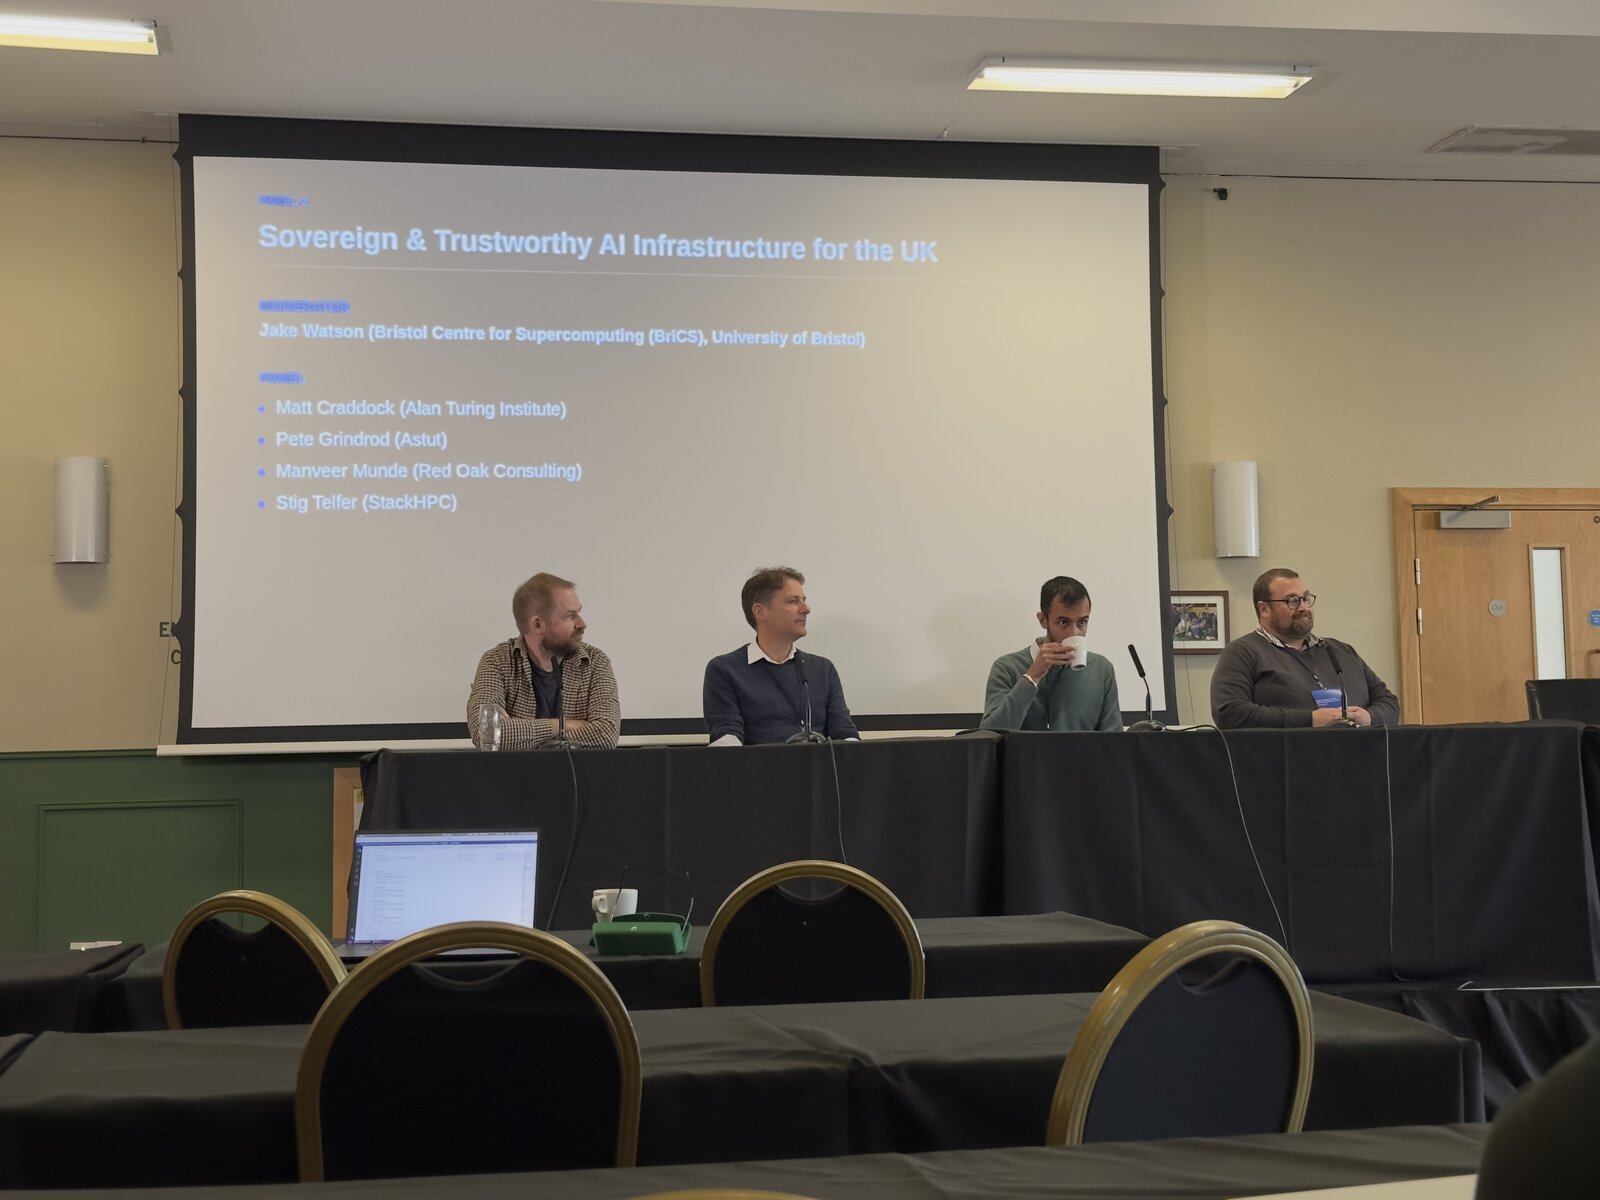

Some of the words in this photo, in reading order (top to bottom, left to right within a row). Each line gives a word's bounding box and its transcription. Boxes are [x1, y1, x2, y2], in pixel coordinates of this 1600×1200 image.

[300, 196, 310, 207] 2
[258, 224, 399, 256] Sovereign
[405, 228, 427, 252] &
[433, 229, 593, 261] Trustworthy
[600, 233, 626, 256] AI
[633, 234, 807, 261] Infrastructure
[812, 237, 849, 261] for
[854, 239, 894, 263] the
[900, 240, 938, 264] UK
[258, 323, 298, 339] Jake
[302, 324, 364, 340] Watson
[368, 323, 428, 342] (Bristol
[431, 326, 486, 341] Centre
[488, 326, 512, 342] for
[515, 327, 645, 347] Supercomputing
[648, 329, 708, 348] (BriCS),
[712, 330, 788, 349] University
[792, 331, 809, 346] of
[811, 332, 867, 350] Bristol)
[276, 400, 312, 416] Matt
[317, 400, 395, 416] Craddock
[399, 400, 442, 419] (Alan
[446, 401, 496, 420] Turing
[499, 401, 567, 420] Institute)
[276, 431, 314, 447] Pete
[318, 431, 390, 448] Grindrod
[394, 431, 448, 450] (Astut)
[276, 463, 348, 479] Manveer
[352, 463, 408, 479] Munde
[412, 463, 452, 481] (Red
[456, 463, 490, 480] Oak
[493, 463, 583, 482] Consulting)
[276, 495, 309, 514] Stig
[312, 495, 358, 511] Telfer
[362, 494, 458, 513] (StackHPC)
